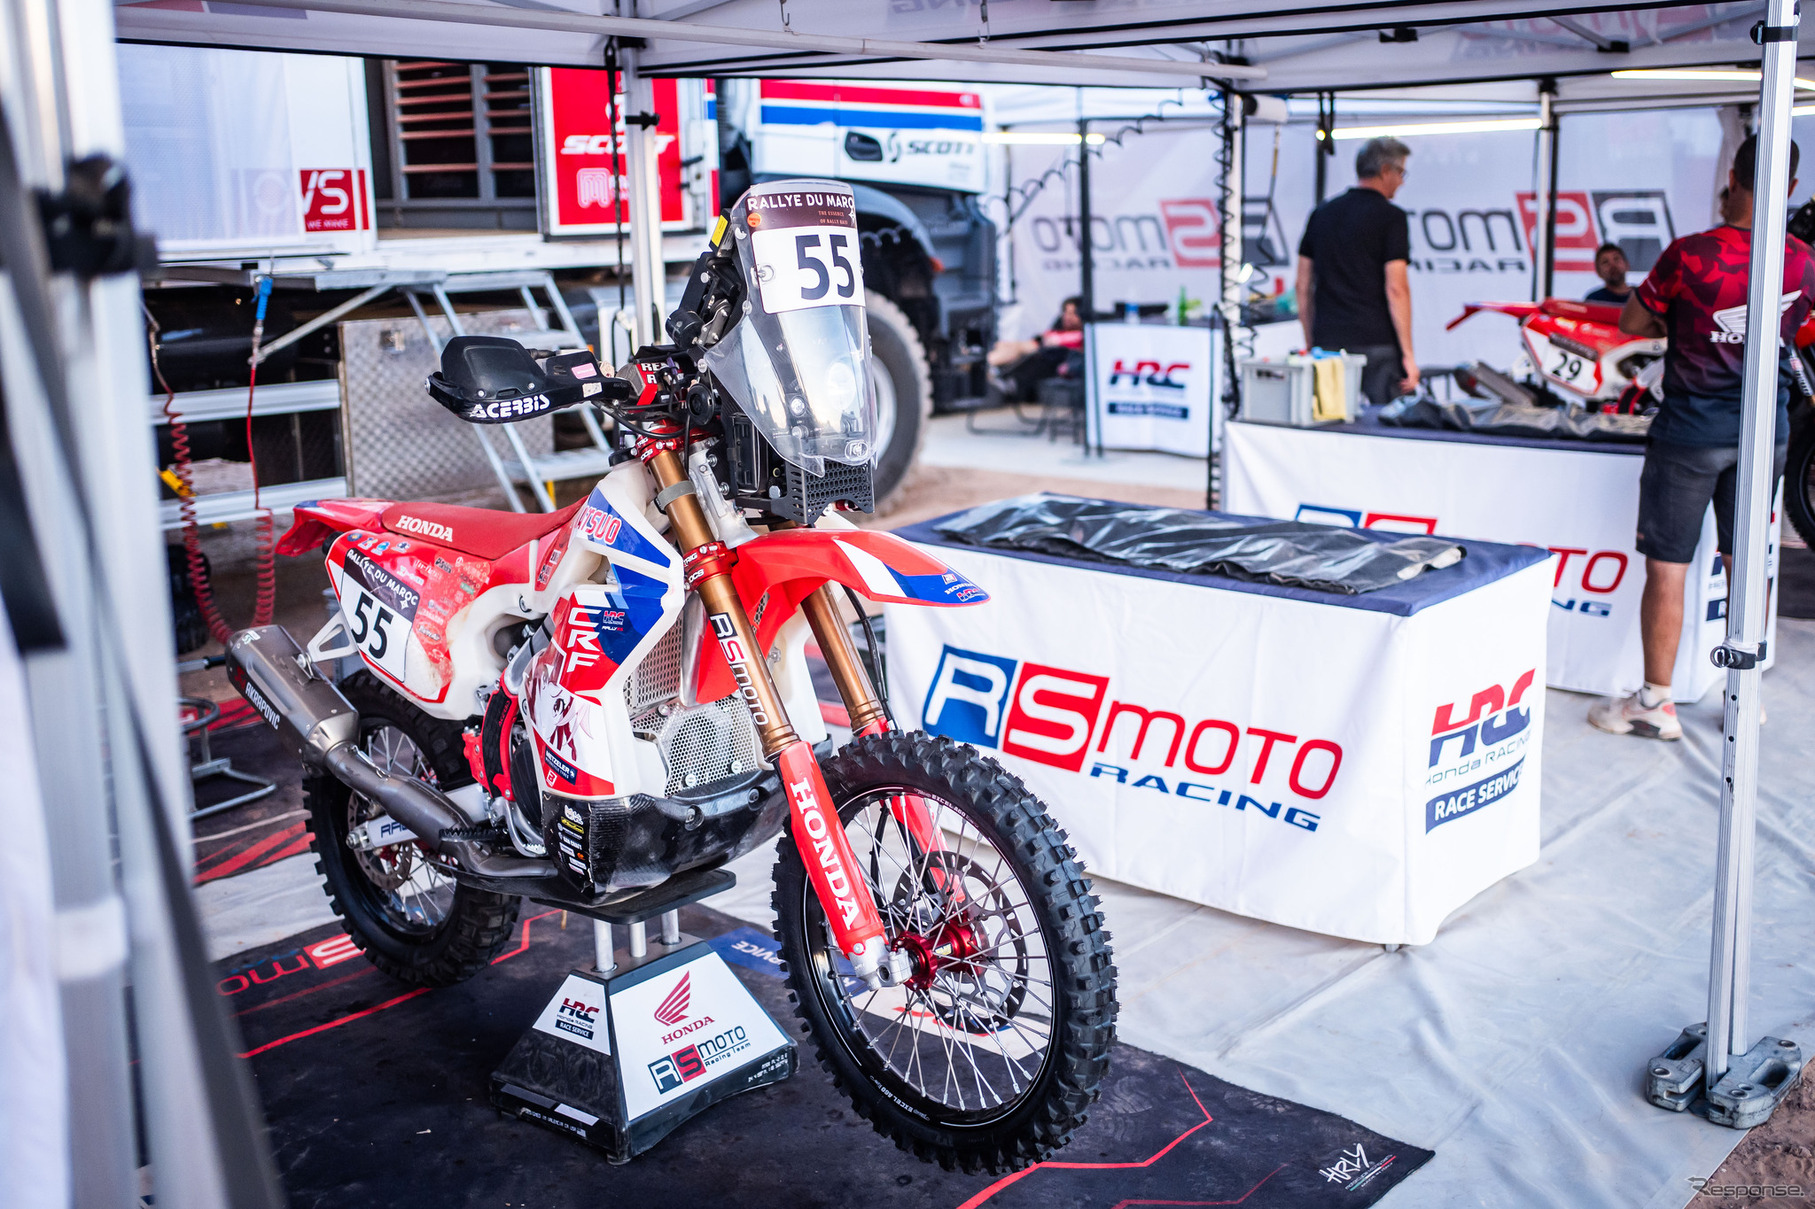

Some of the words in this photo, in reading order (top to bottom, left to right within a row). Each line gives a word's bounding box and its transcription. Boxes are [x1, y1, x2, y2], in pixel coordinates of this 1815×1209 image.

[561, 135, 676, 156] SCOT
[747, 194, 803, 211] RALLYE
[806, 194, 824, 207] DU
[795, 234, 855, 300] 55
[1110, 361, 1190, 389] HRC
[1551, 352, 1583, 381] 29
[396, 514, 454, 543] HONDA
[347, 549, 375, 575] RALLYE
[374, 568, 388, 583] DU
[385, 577, 419, 606] MAROC
[351, 591, 394, 661] 55
[567, 607, 602, 673] CRF
[1429, 668, 1536, 769] HRC
[931, 793, 954, 809] EXCEL
[1090, 761, 1321, 832] RACING
[1434, 788, 1477, 822] RACE
[789, 777, 860, 931] HONDA
[559, 997, 600, 1024] HRC
[559, 1021, 573, 1031] RACE
[571, 1025, 590, 1038] SERVICE
[661, 1016, 715, 1045] HONDA
[705, 1051, 732, 1068] Racing
[732, 1041, 752, 1054] Team
